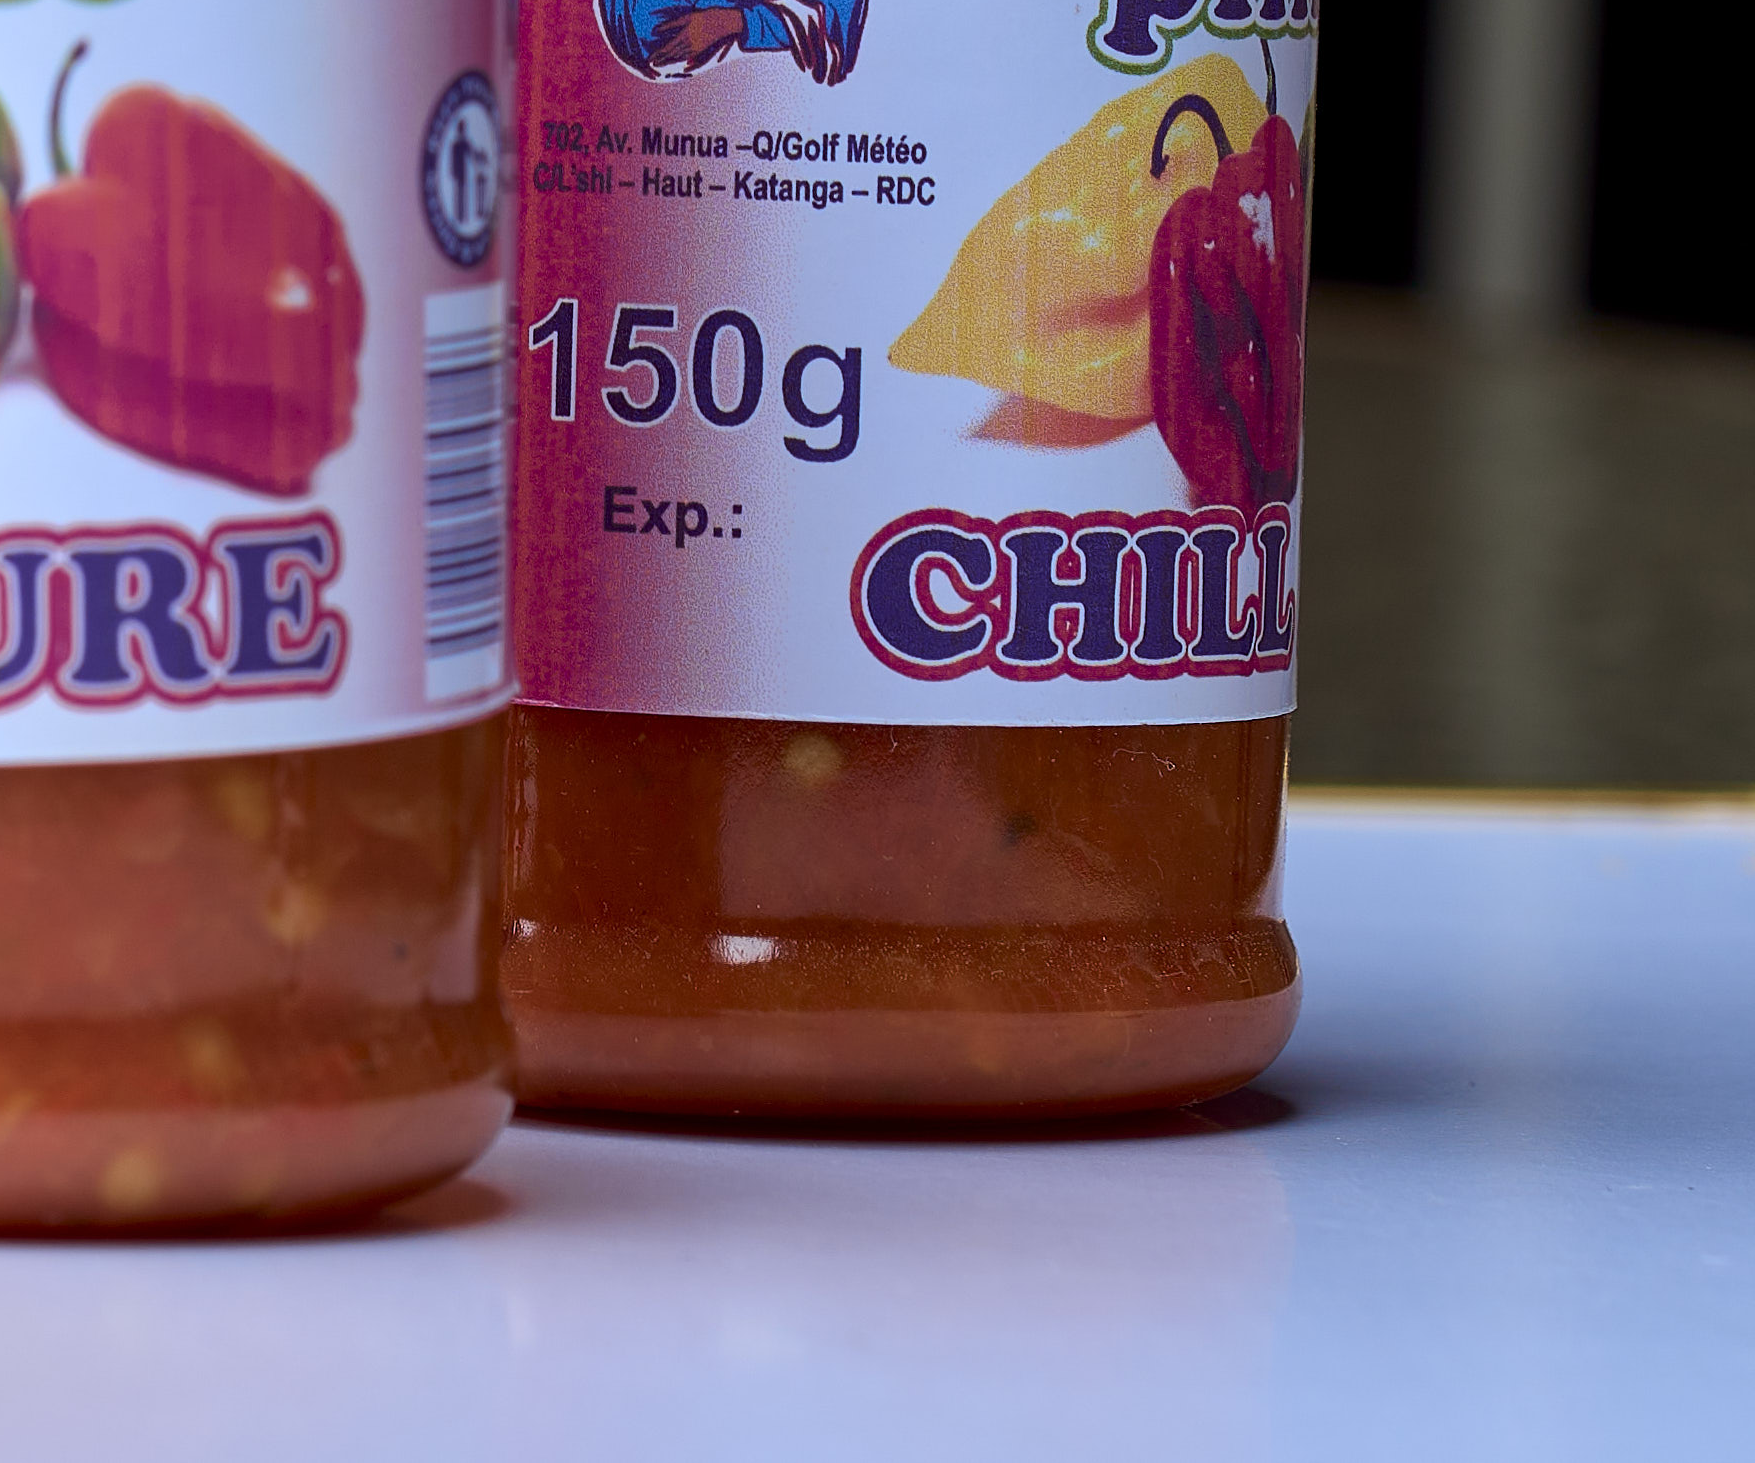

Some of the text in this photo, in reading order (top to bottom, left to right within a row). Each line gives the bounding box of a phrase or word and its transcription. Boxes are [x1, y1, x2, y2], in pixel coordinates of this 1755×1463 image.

[543, 121, 590, 157] 702,
[596, 125, 634, 154] Av.
[642, 126, 729, 158] Munua
[847, 133, 928, 165] Météo
[642, 166, 703, 198] Haut
[734, 171, 845, 210] Katanga
[877, 176, 936, 206] RDC
[601, 486, 744, 549] Exp.:
[858, 515, 1294, 670] CHILL
